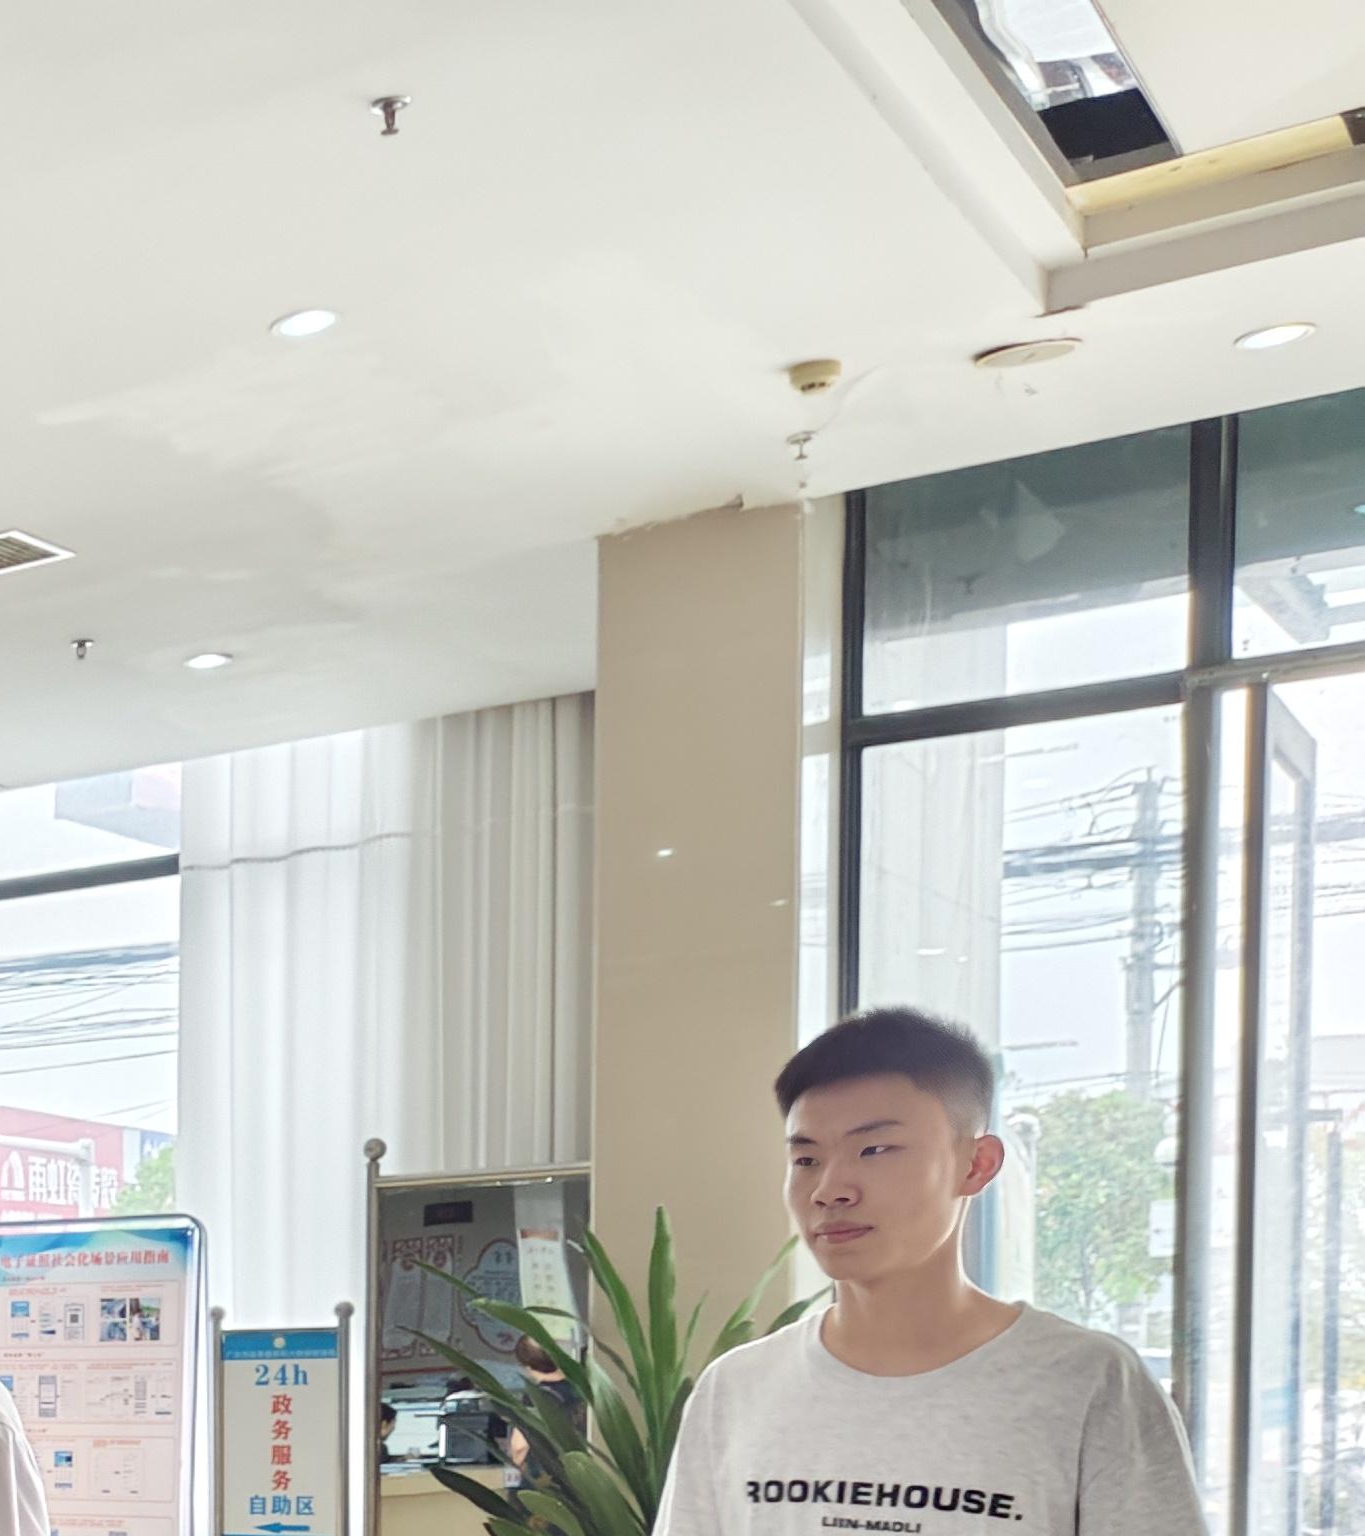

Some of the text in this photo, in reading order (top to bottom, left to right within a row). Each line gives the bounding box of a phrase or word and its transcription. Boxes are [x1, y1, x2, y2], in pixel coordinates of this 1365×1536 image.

[255, 1363, 309, 1386] 24h
[271, 1393, 293, 1491] 政务服务
[249, 1494, 315, 1516] 自助区
